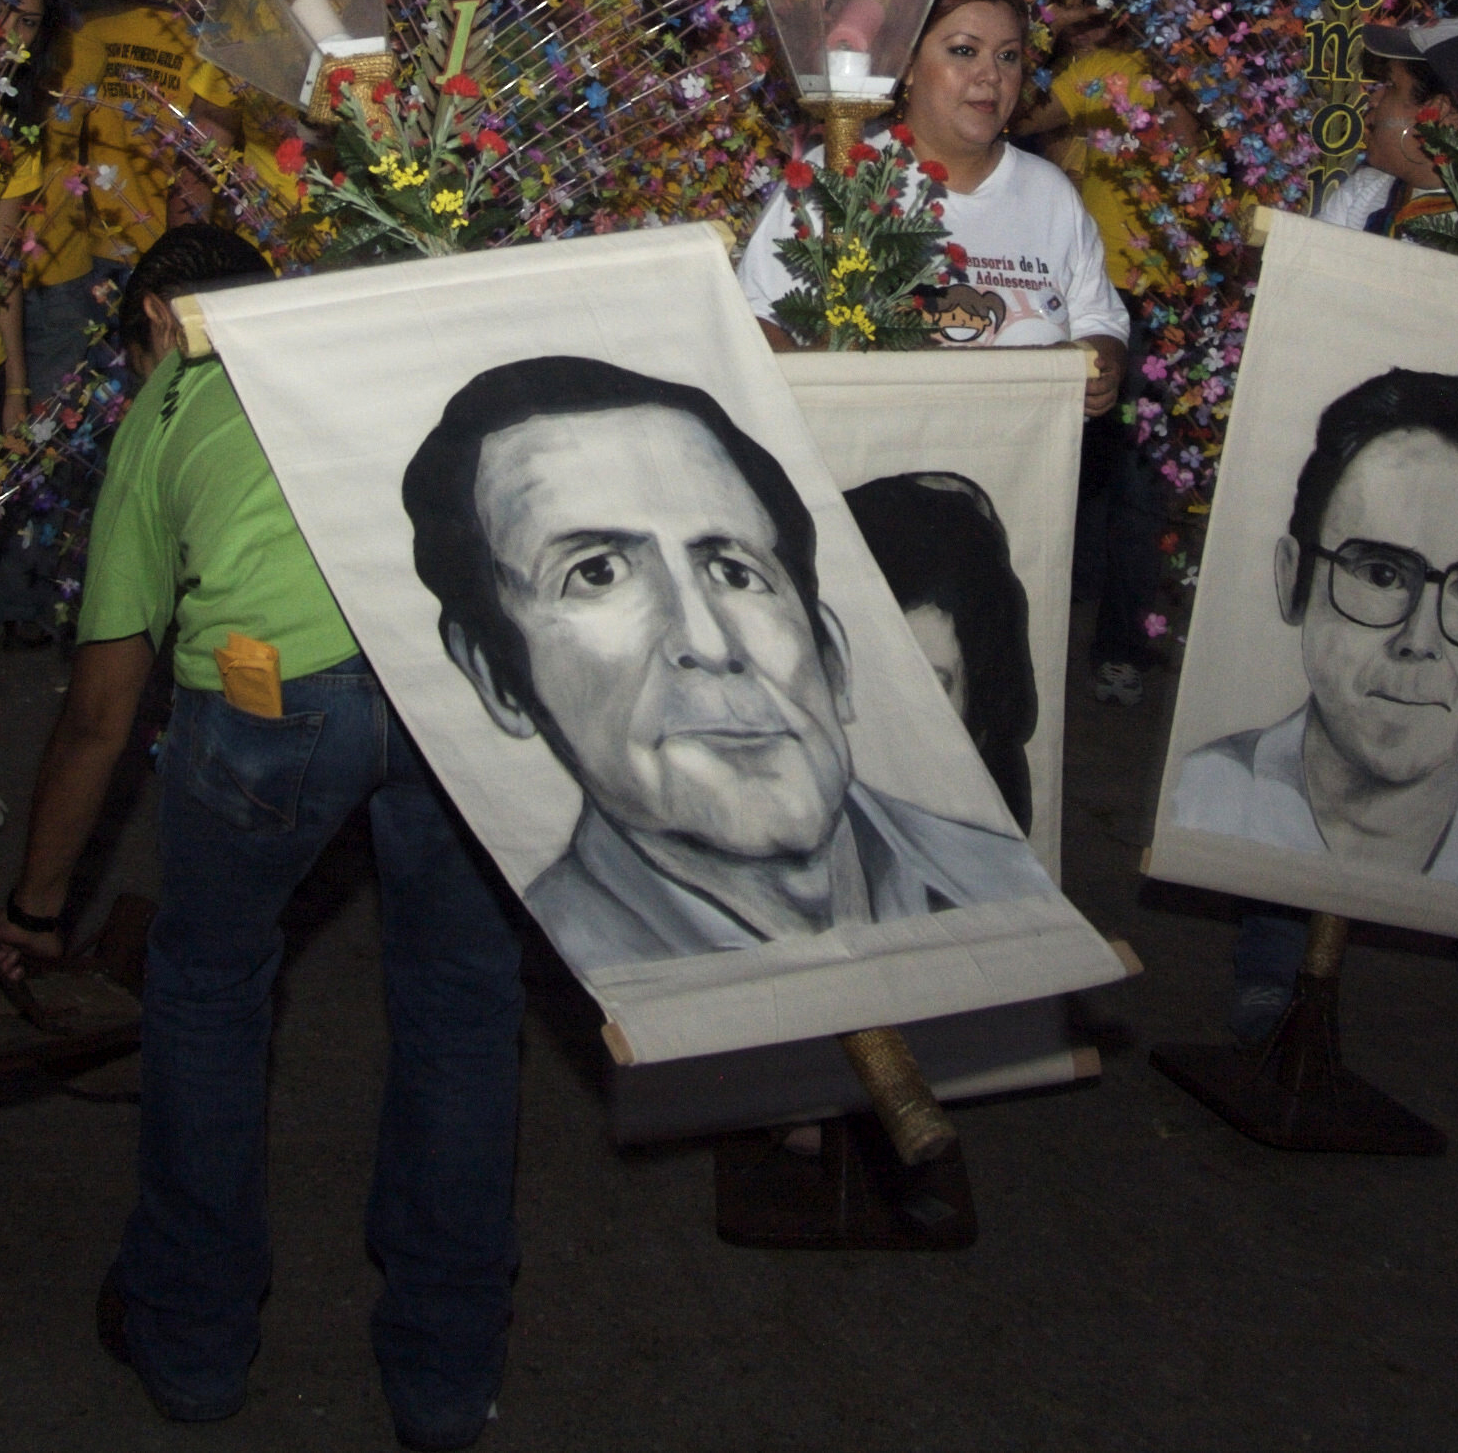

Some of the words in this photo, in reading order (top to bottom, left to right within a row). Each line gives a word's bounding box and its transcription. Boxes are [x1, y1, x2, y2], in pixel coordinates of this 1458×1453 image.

[966, 255, 1016, 271] ensoría
[1019, 255, 1034, 273] de
[1036, 257, 1049, 274] la
